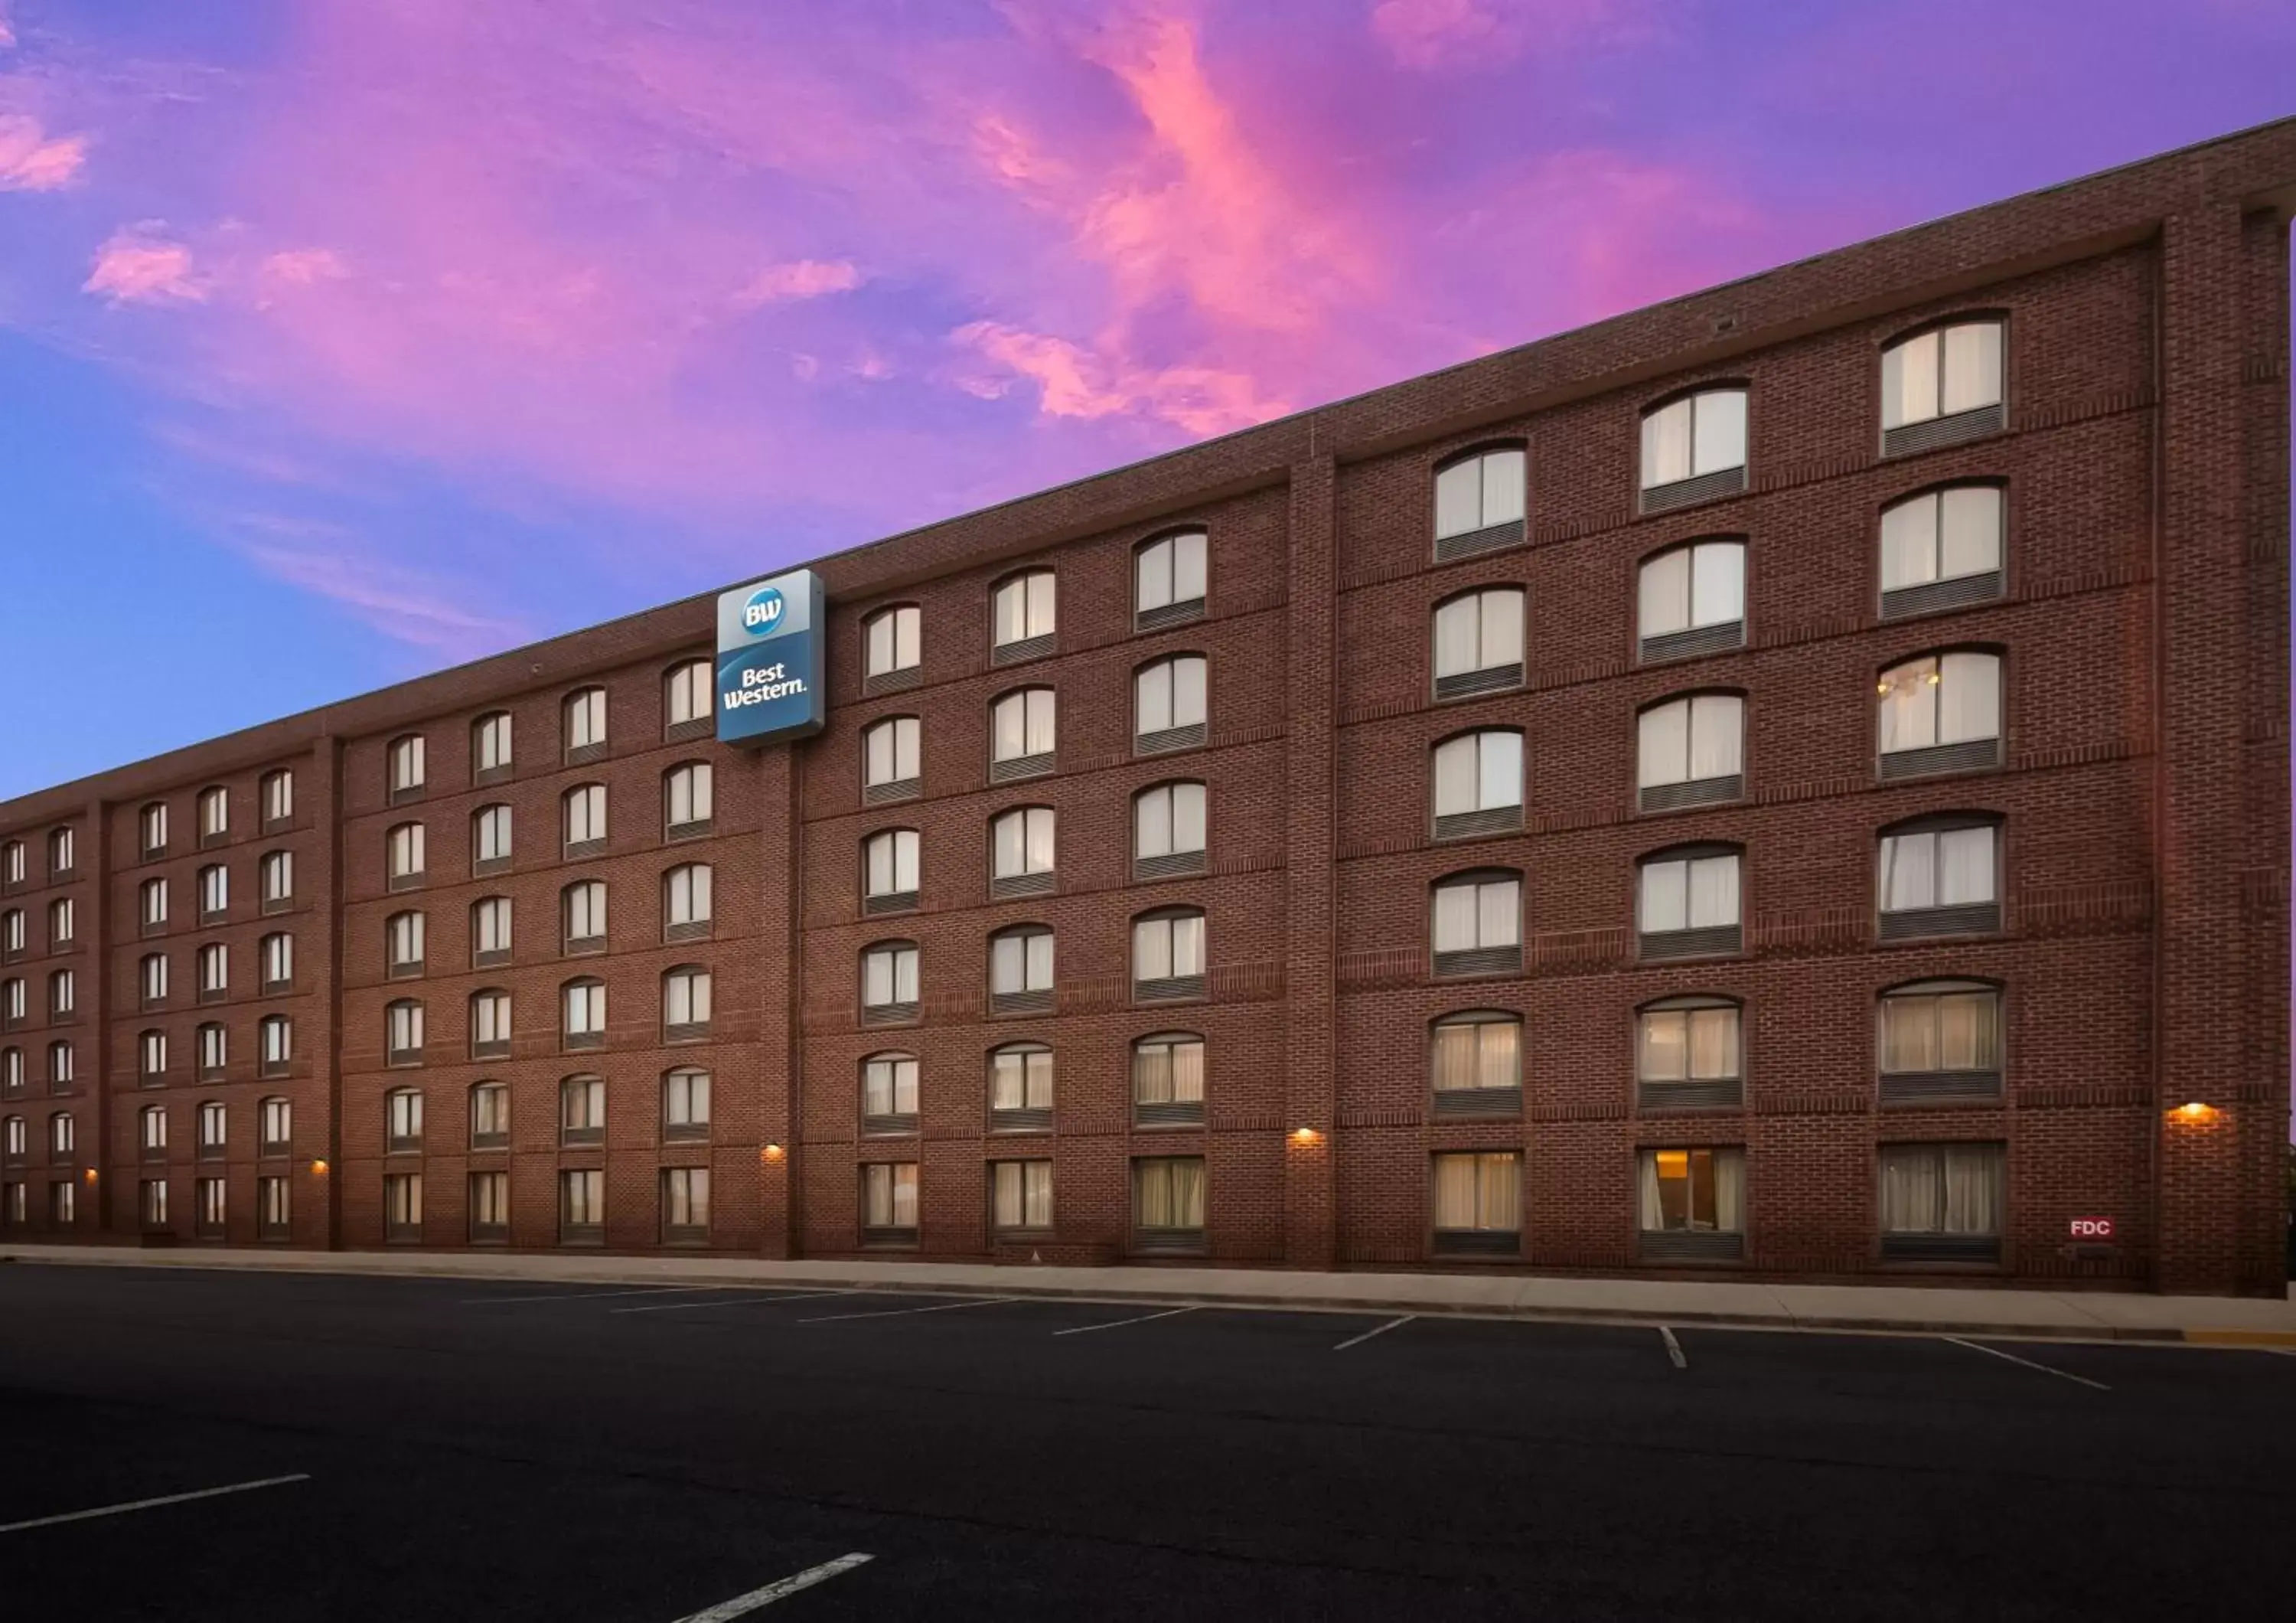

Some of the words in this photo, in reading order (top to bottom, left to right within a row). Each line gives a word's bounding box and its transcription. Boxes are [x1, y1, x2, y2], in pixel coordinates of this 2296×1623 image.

[745, 598, 782, 627] BW
[742, 662, 784, 688] Best
[2071, 1220, 2110, 1235] FDC
